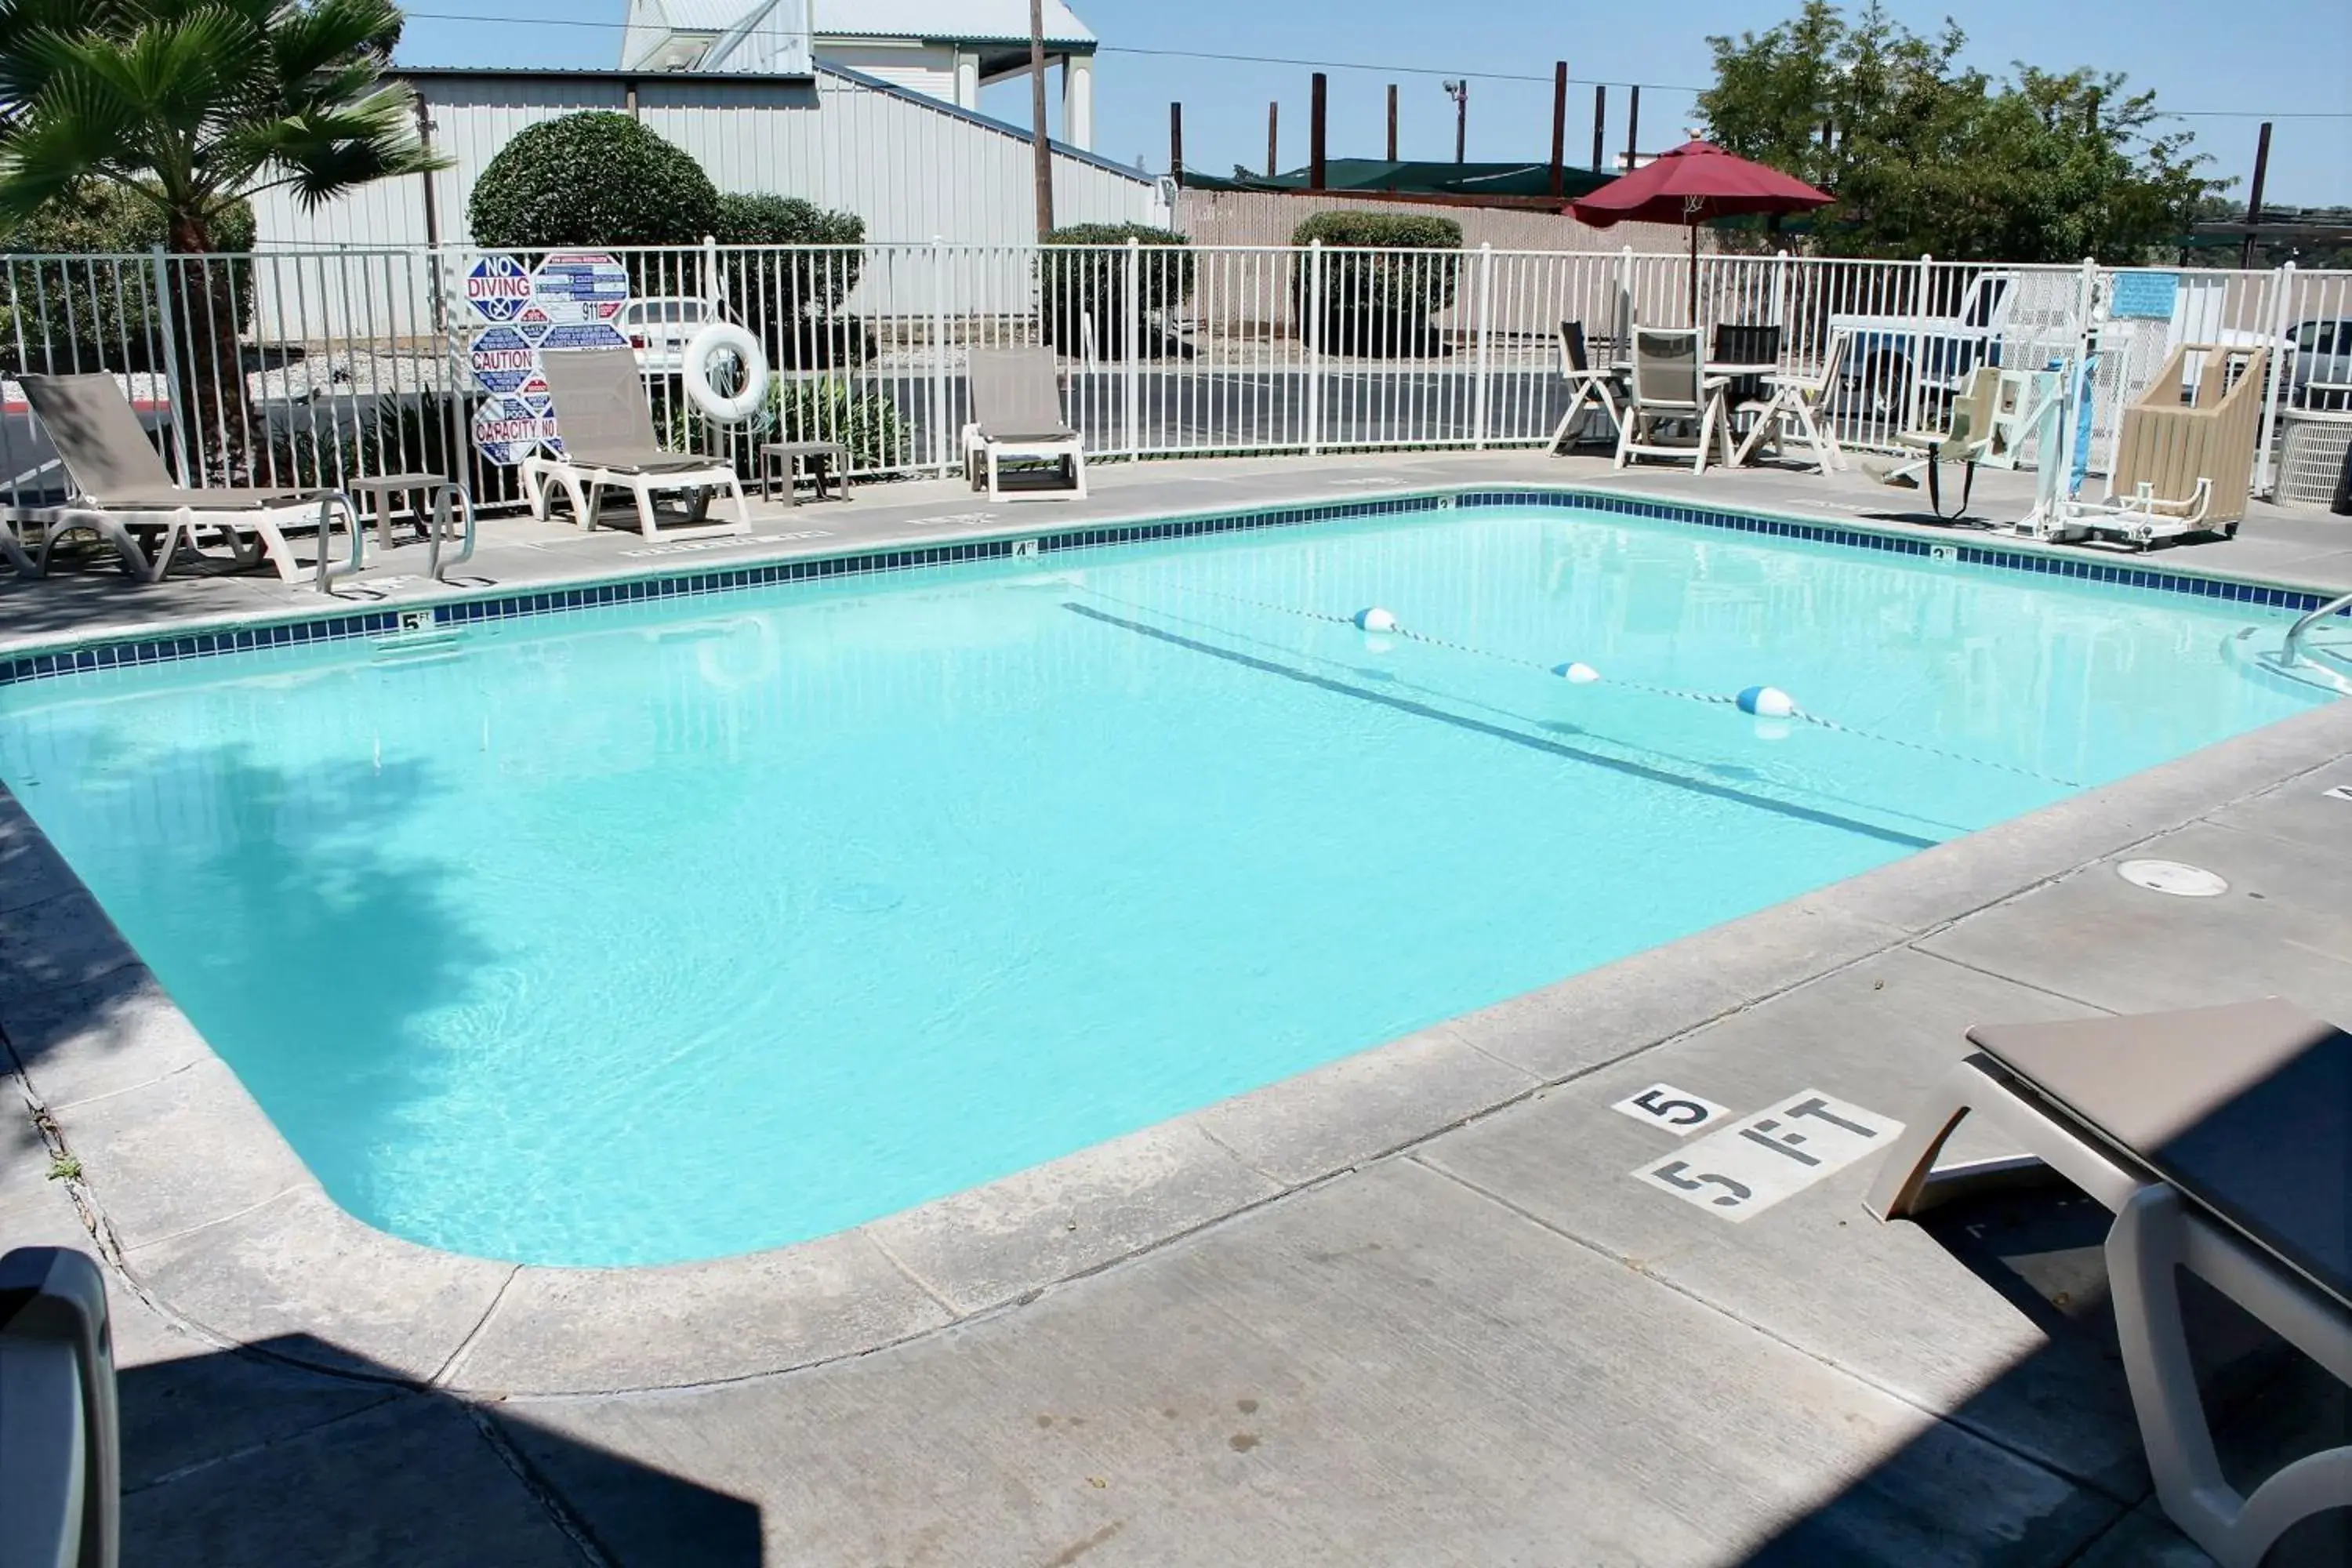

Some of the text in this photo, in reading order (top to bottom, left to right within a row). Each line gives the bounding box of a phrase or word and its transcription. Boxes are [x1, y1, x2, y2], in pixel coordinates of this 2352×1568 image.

[485, 257, 511, 277] NO
[467, 277, 531, 297] DIVING
[583, 302, 598, 321] 911
[471, 351, 533, 371] CAUTION
[506, 410, 530, 420] POOL
[476, 420, 537, 441] CAPACITY
[542, 420, 555, 437] NO
[402, 614, 419, 630] 5
[1632, 1091, 1708, 1125] 5
[1650, 1098, 1878, 1206] 5 FT
